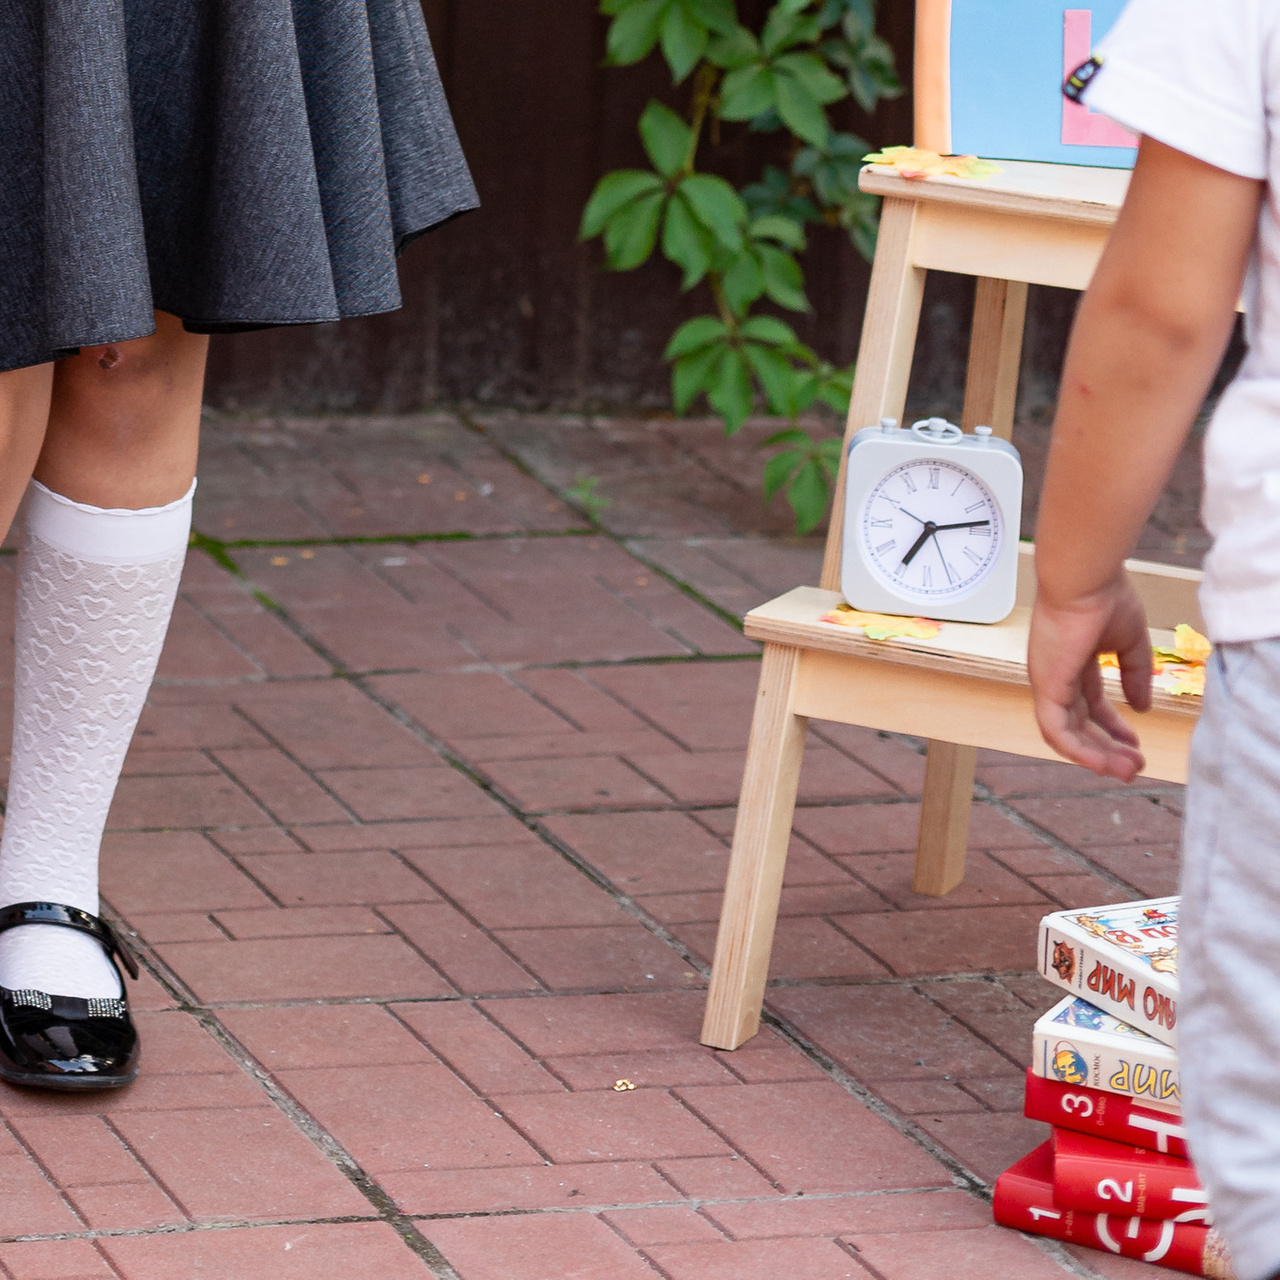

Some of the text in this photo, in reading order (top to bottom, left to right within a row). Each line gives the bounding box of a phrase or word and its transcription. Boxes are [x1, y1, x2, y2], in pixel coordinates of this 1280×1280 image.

[1087, 960, 1136, 1011] МИР
[1093, 1054, 1102, 1087] КОСМОС
[1061, 1092, 1094, 1118] 3
[1097, 1178, 1134, 1203] 2
[1028, 1207, 1062, 1221] 1
